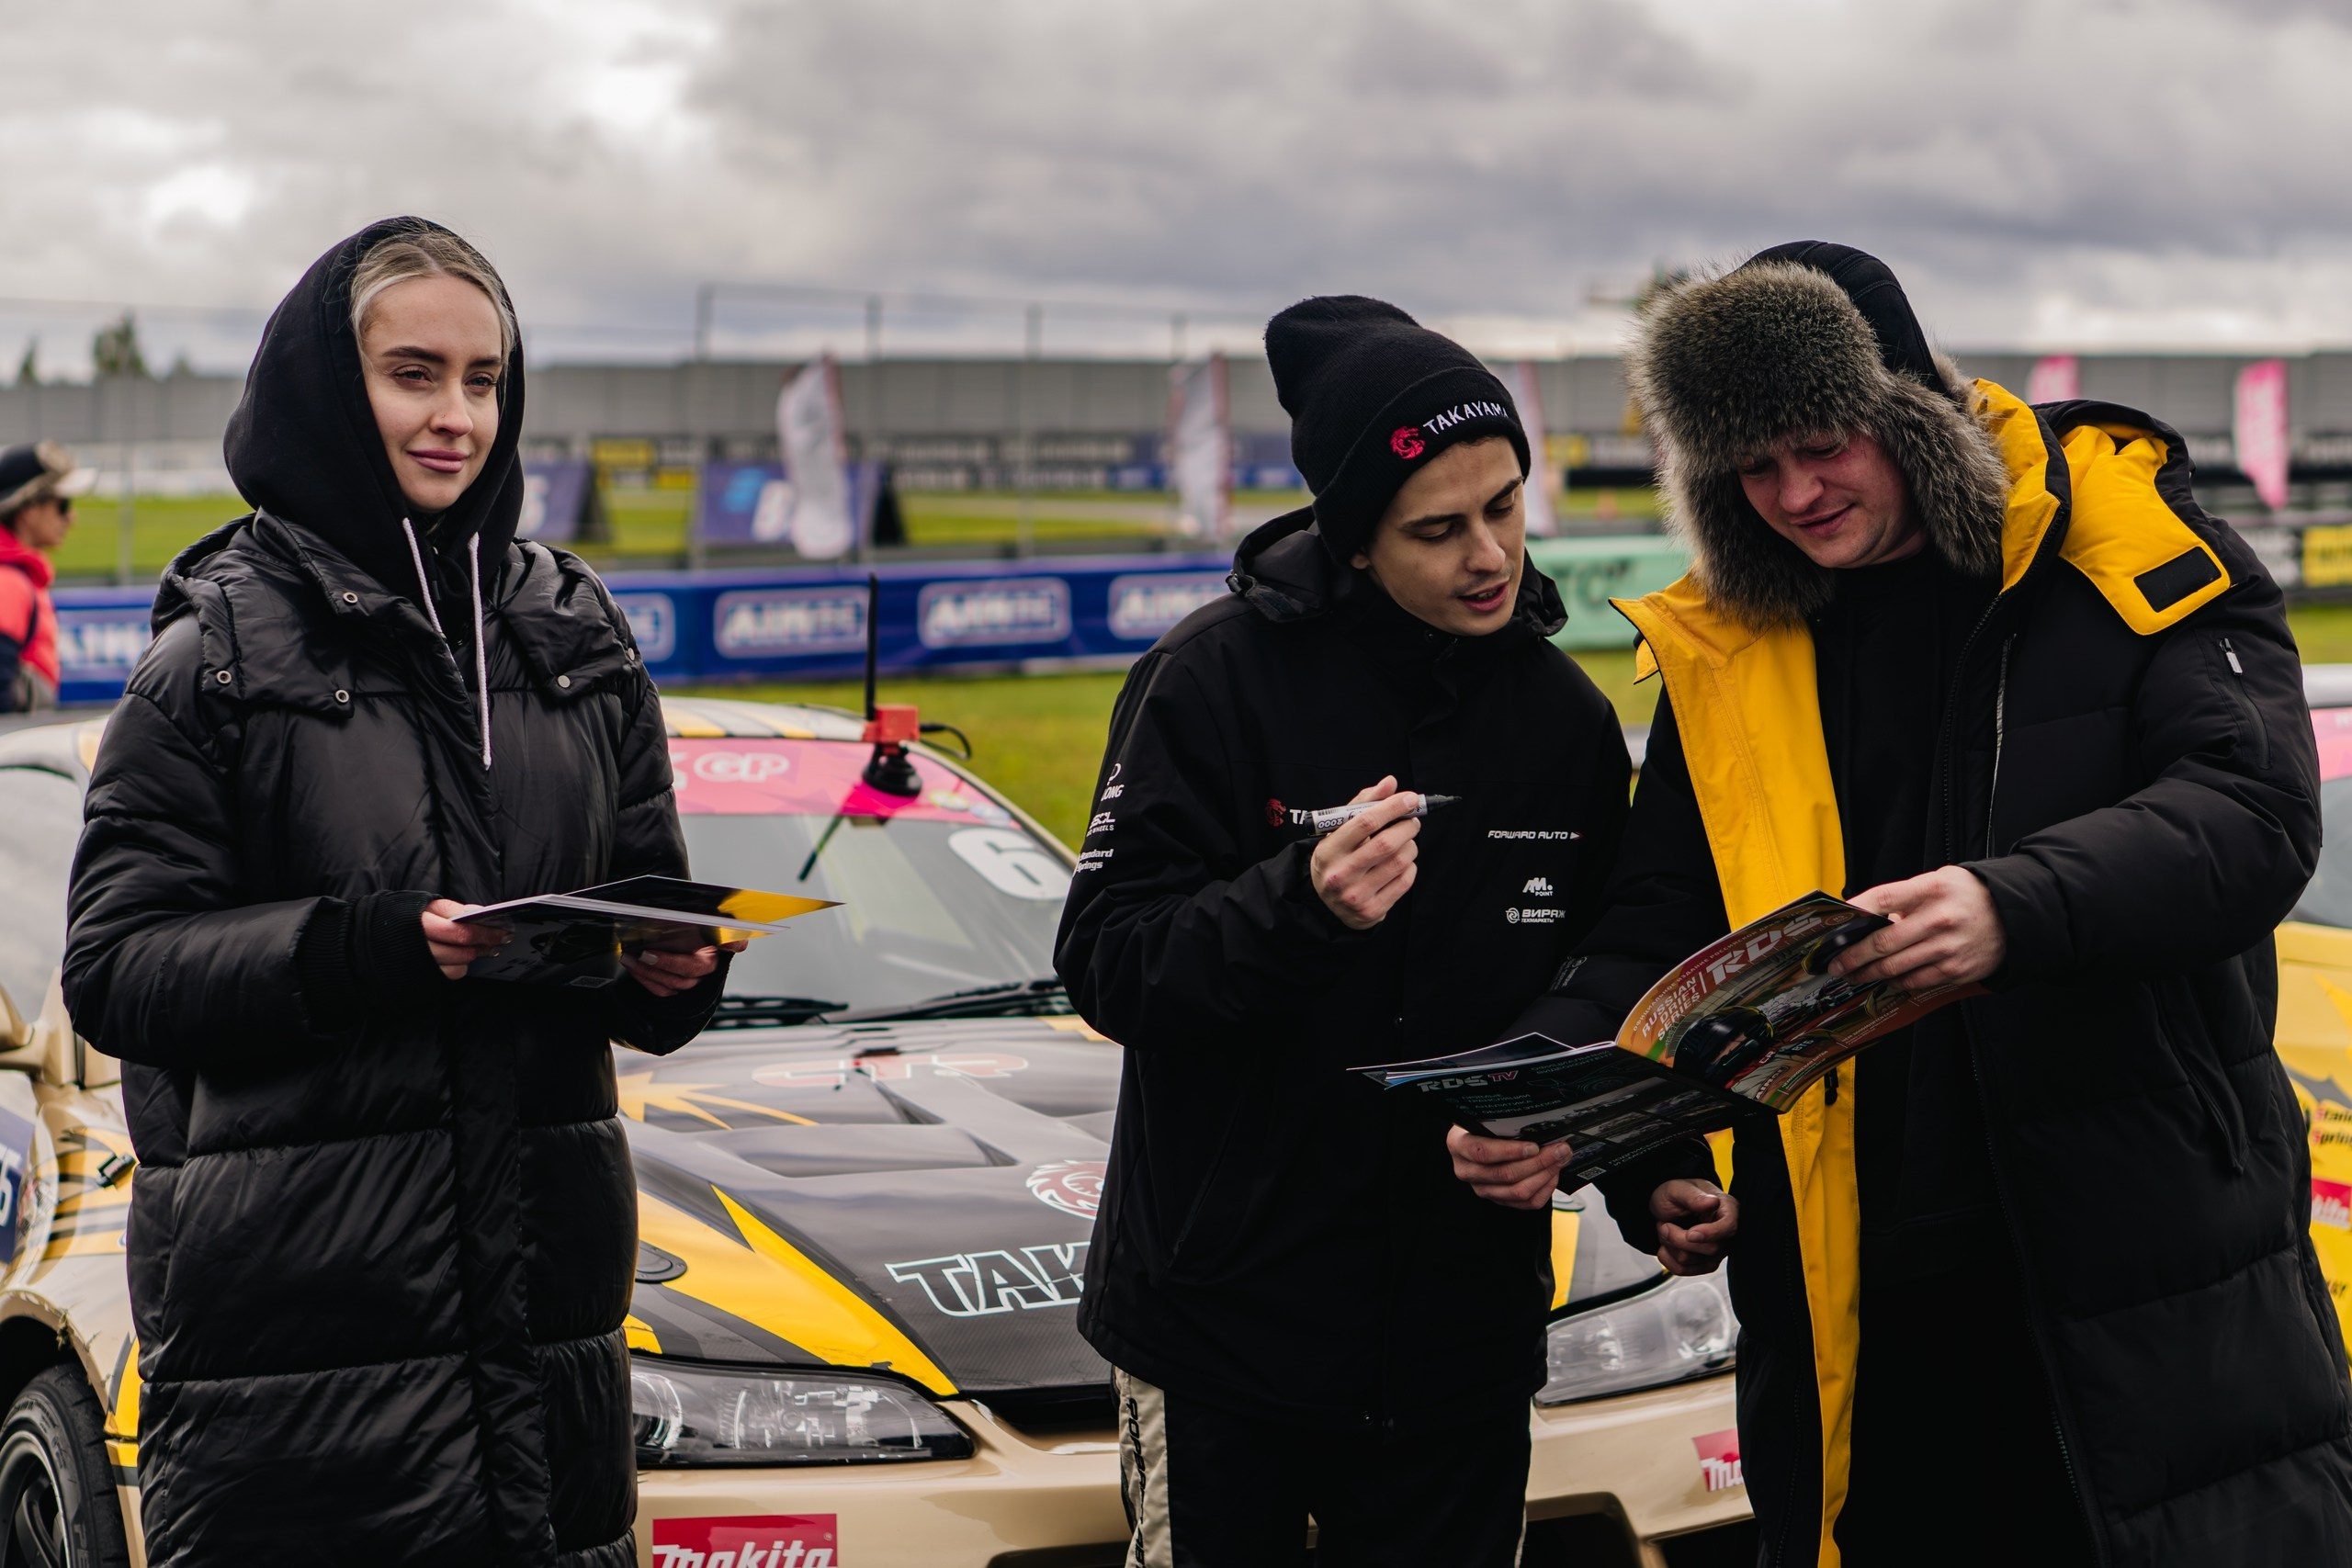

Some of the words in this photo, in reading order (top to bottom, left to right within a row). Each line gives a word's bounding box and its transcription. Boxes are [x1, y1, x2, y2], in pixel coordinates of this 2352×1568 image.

[1317, 817, 1344, 829] 2000
[1487, 830, 1536, 839] FORWARD
[1538, 831, 1568, 840] AUTO
[1521, 909, 1566, 919] ВИРАЖ
[1705, 909, 1823, 986] RDS
[1642, 976, 1697, 1038] RUSSIAN
[1657, 991, 1701, 1042] SERIES
[1659, 983, 1699, 1025] DRIFT
[1417, 1073, 1489, 1093] RDS
[1487, 1069, 1519, 1083] TV
[884, 1242, 1091, 1317] TAK
